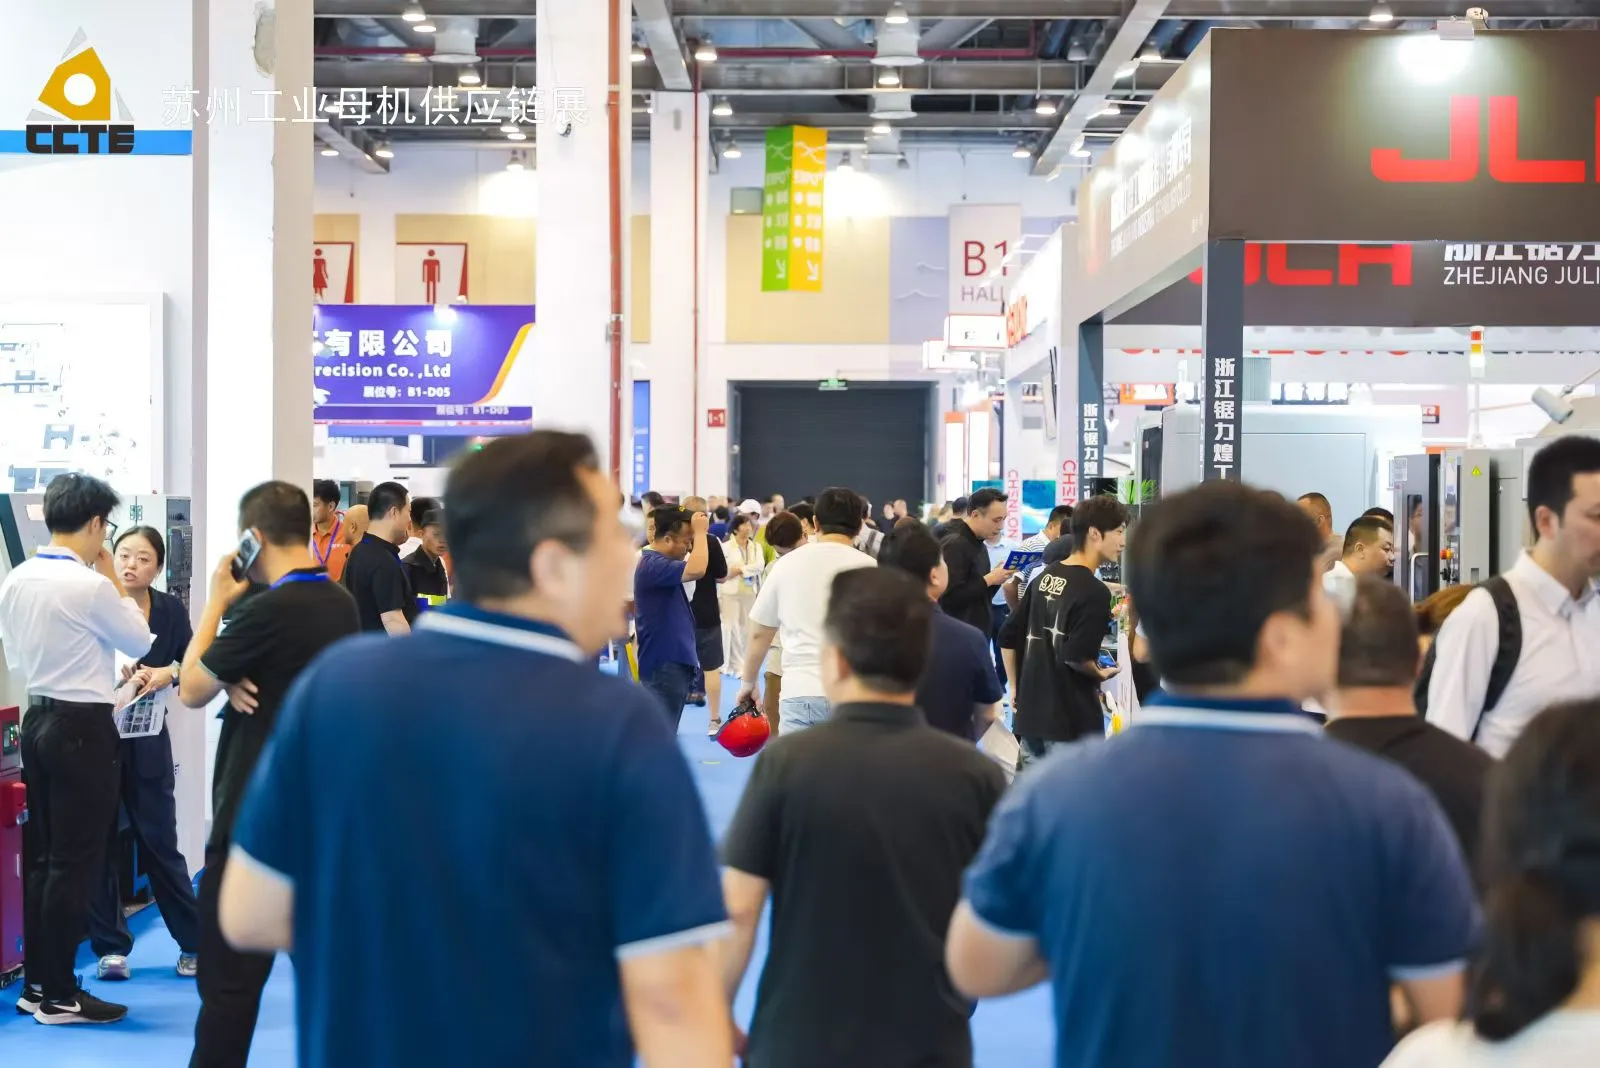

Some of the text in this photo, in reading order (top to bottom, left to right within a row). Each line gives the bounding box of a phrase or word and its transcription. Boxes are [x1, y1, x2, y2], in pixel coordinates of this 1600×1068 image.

[1371, 95, 1600, 183] JL
[963, 240, 1008, 277] B1
[1443, 266, 1548, 285] ZHEJIANG
[386, 363, 414, 378] Co.
[407, 386, 451, 397] B1-D05
